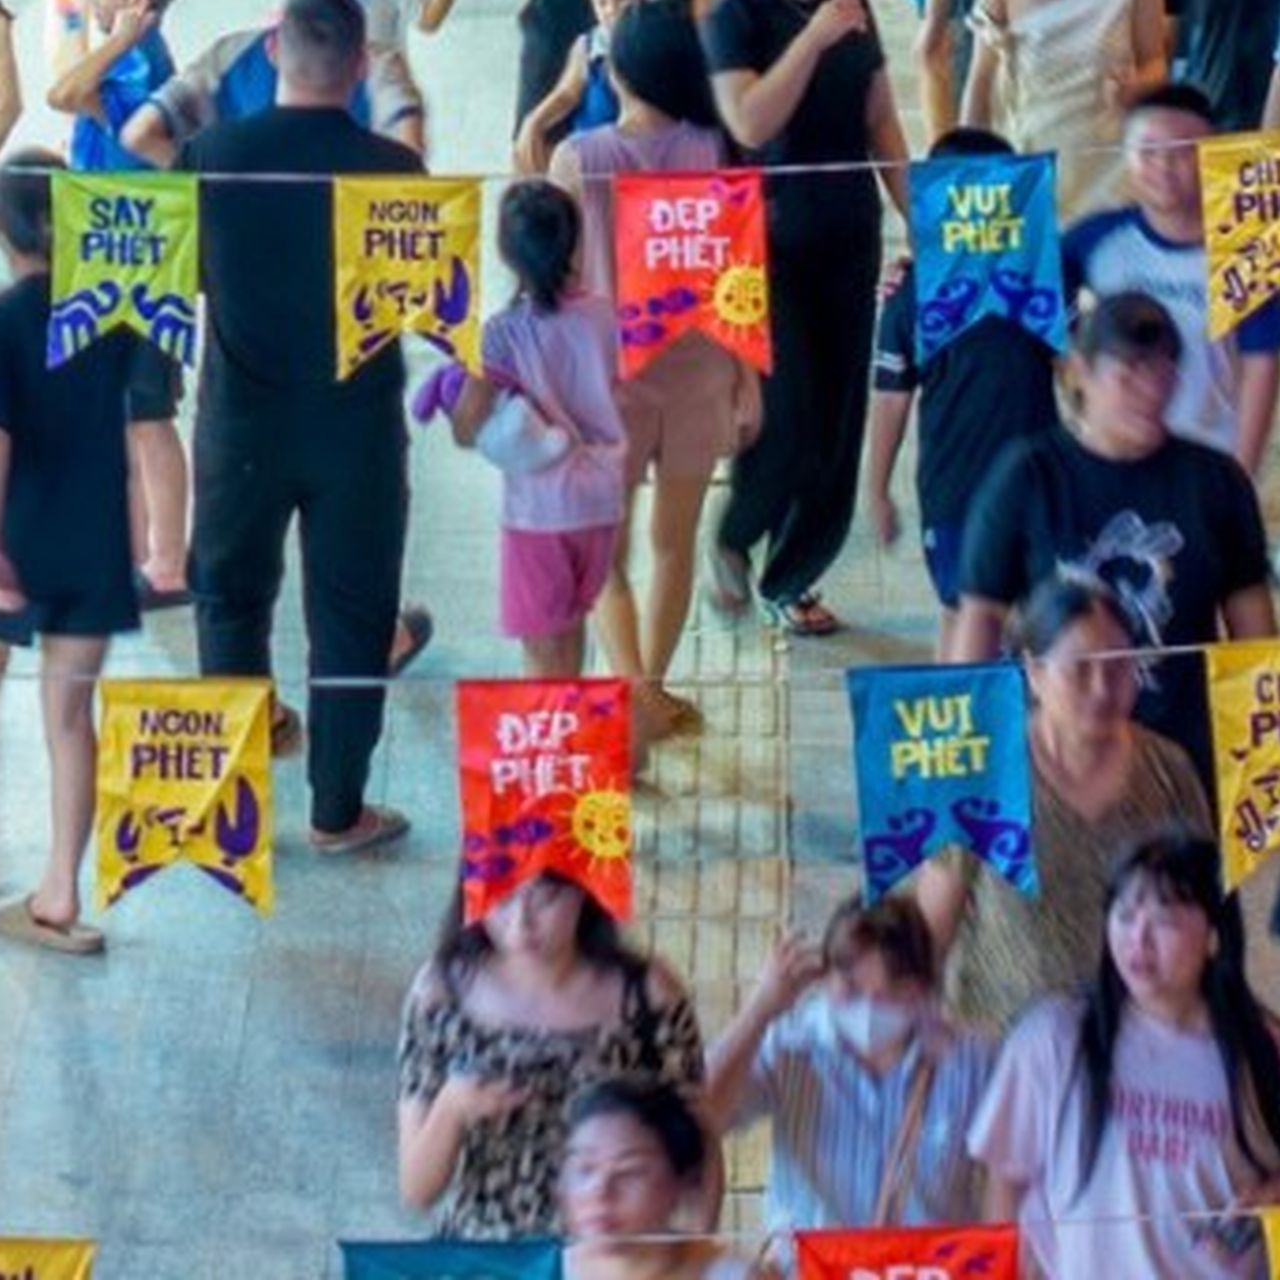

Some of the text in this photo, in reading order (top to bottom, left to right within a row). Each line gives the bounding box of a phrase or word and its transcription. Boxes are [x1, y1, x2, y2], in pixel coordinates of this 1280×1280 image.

[89, 196, 153, 230] SAY
[369, 200, 439, 224] NGON
[947, 183, 1014, 221] VUI
[892, 694, 969, 737] VUI
